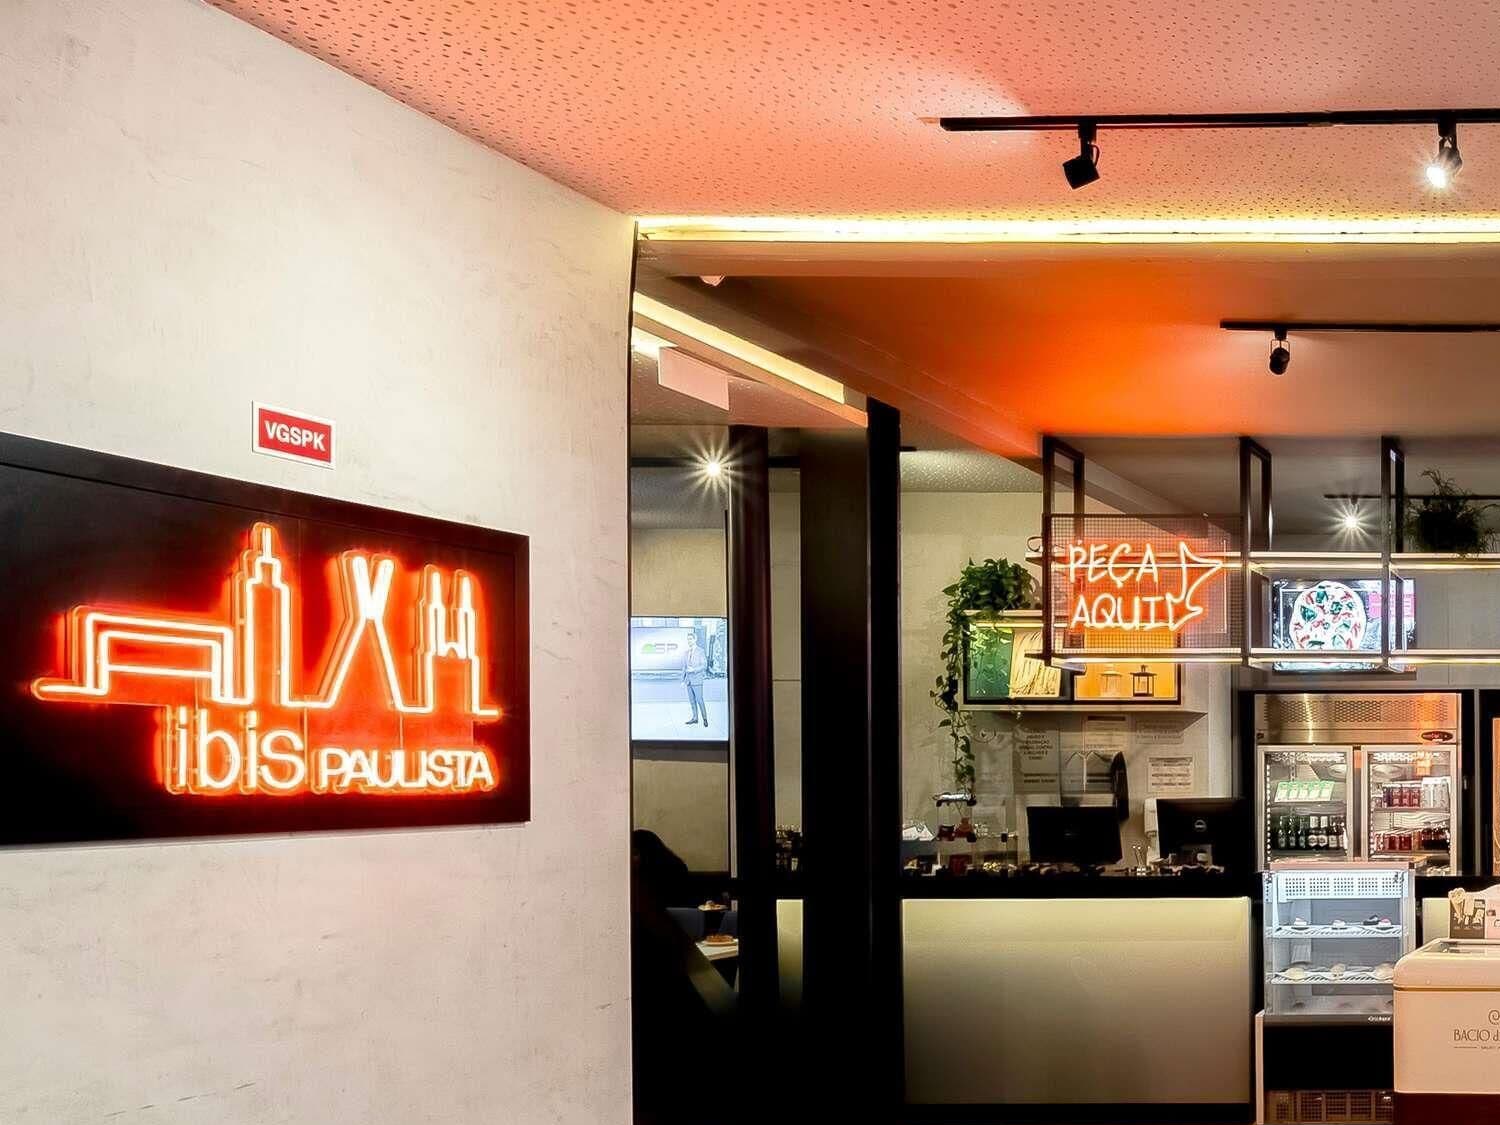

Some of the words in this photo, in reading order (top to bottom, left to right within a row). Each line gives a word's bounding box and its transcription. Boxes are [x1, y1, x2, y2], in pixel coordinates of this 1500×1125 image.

[264, 420, 325, 452] VGSPK
[1069, 543, 1158, 588] PEÇA
[1071, 593, 1164, 630] AQUI
[178, 706, 304, 789] ibis
[319, 748, 494, 788] PAULISTA
[1453, 1029, 1491, 1042] BACIO
